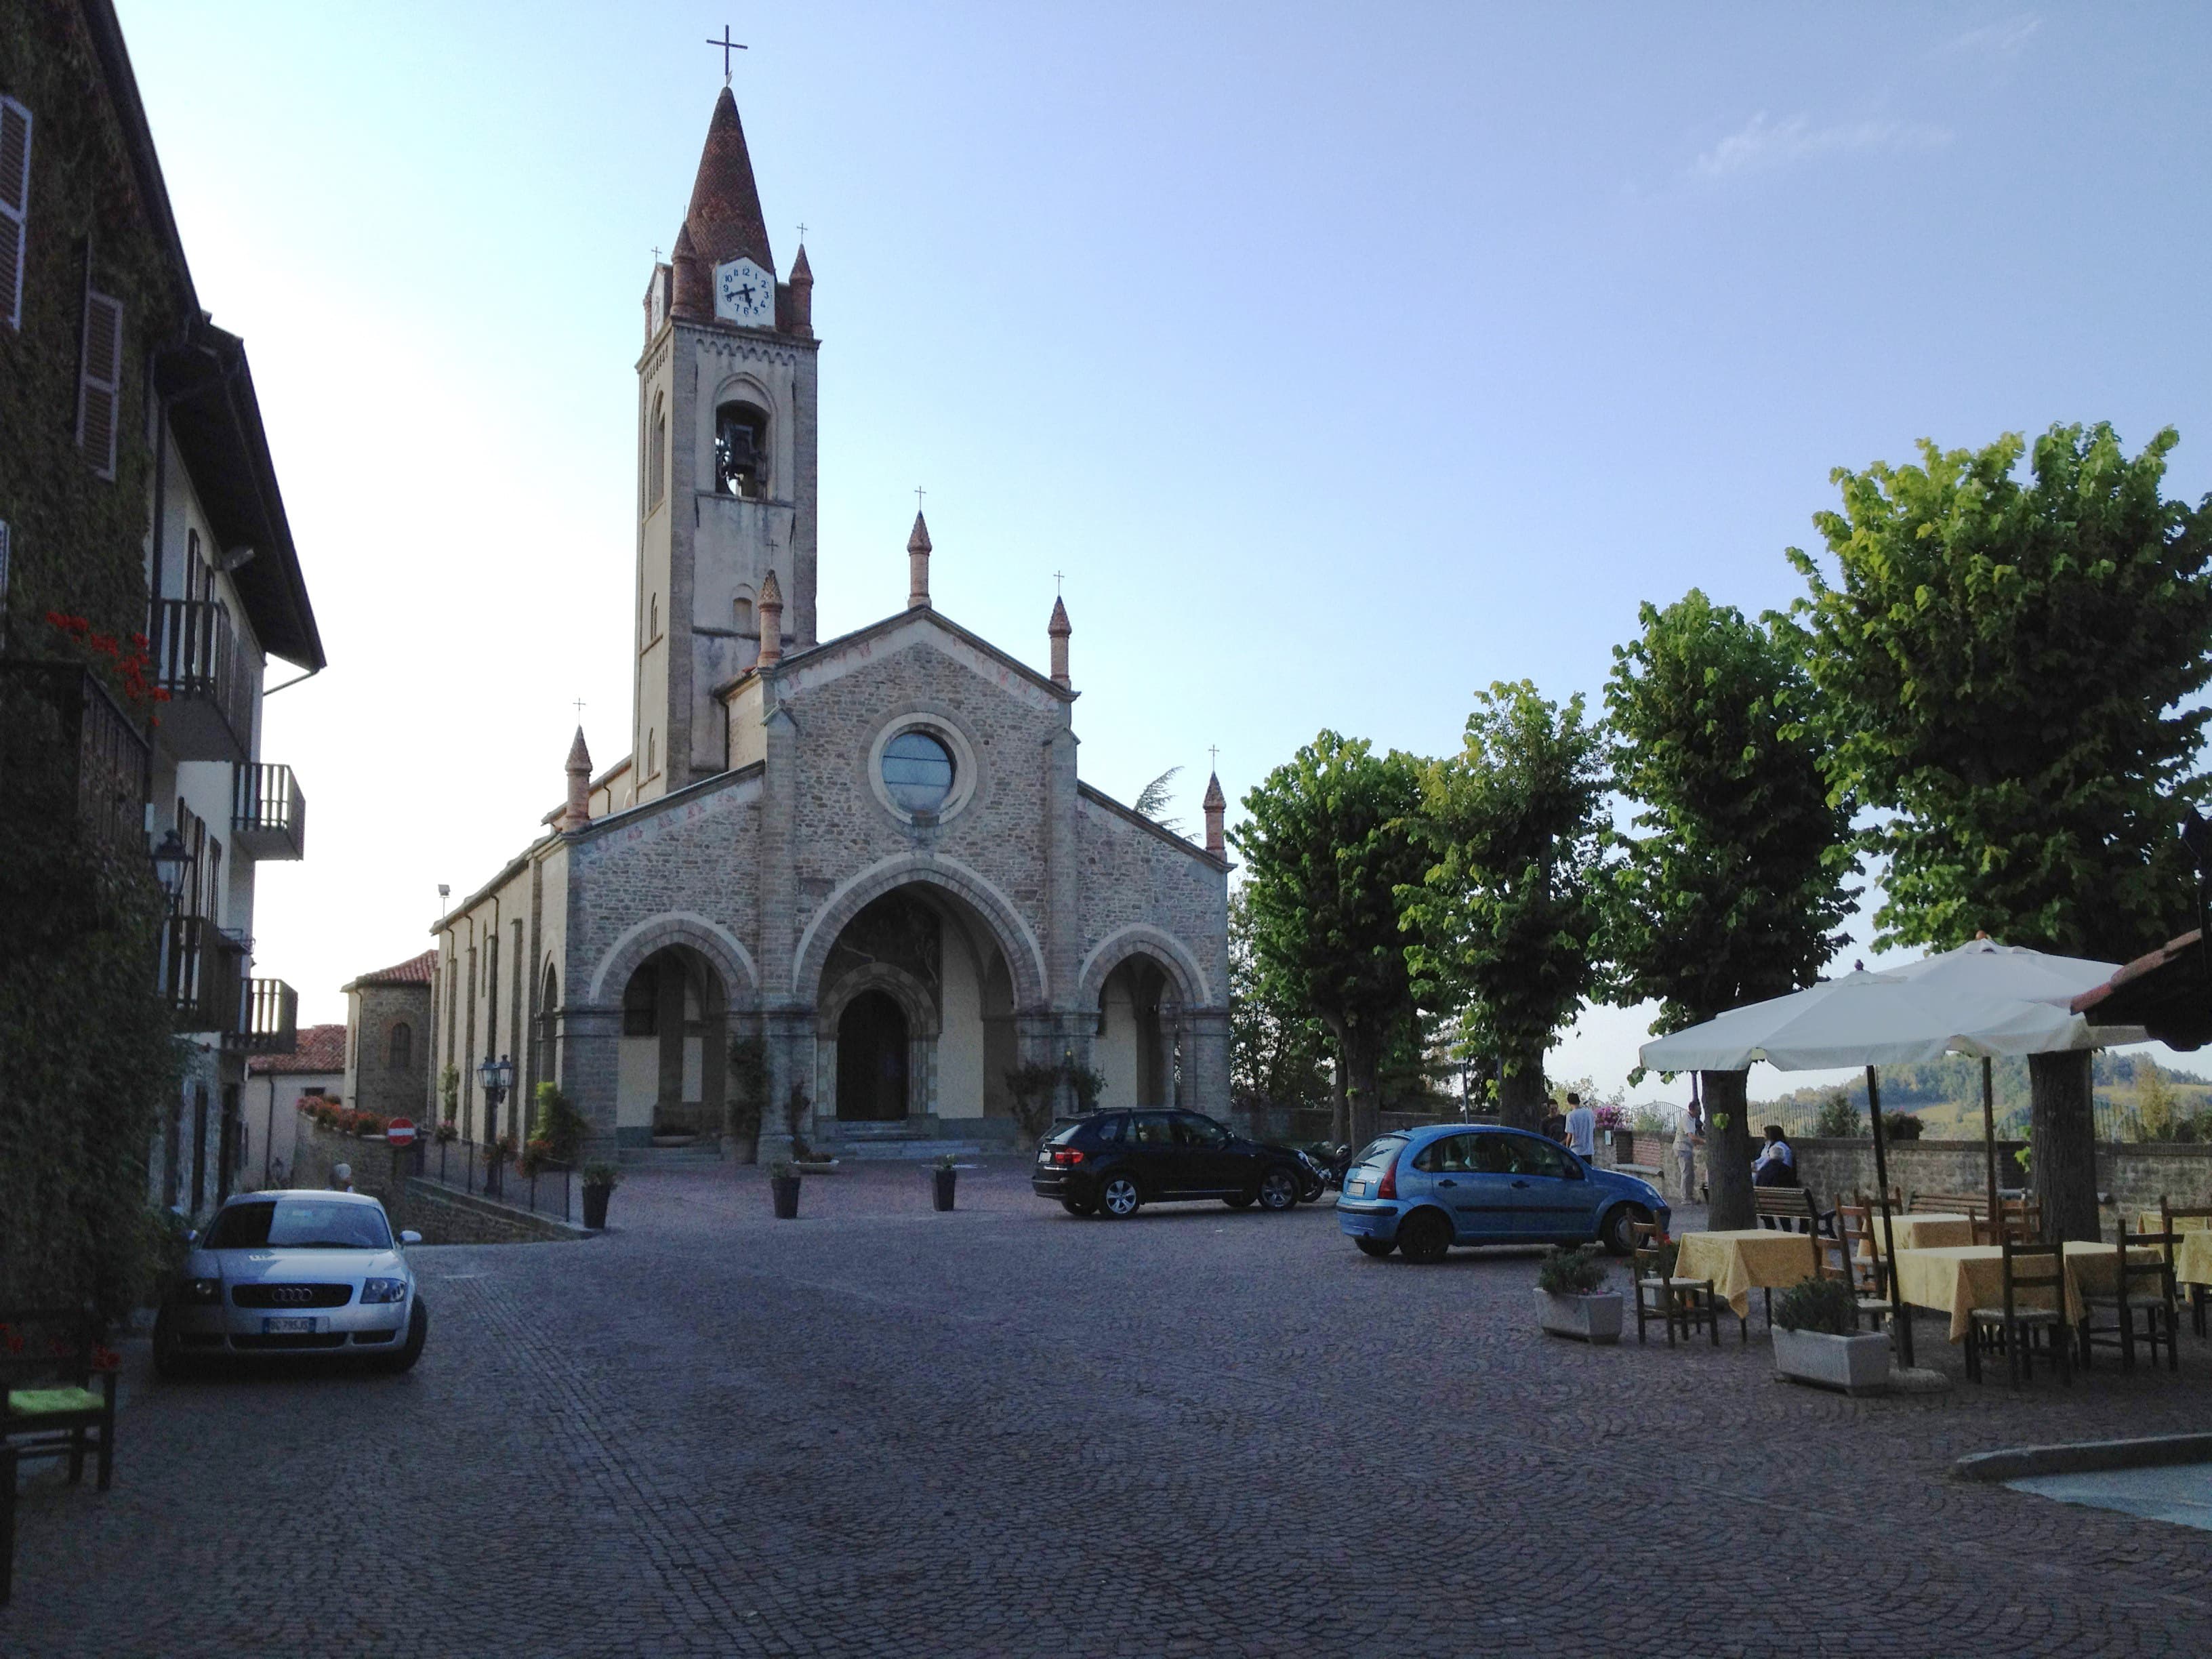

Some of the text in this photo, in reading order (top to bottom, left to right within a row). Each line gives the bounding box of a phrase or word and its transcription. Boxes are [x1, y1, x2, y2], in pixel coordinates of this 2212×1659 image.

[734, 268, 739, 276] 11
[743, 268, 750, 276] 12
[725, 274, 733, 283] 10
[723, 284, 729, 292] 9
[761, 280, 766, 288] 2
[735, 303, 739, 312] 7
[743, 307, 749, 315] 6
